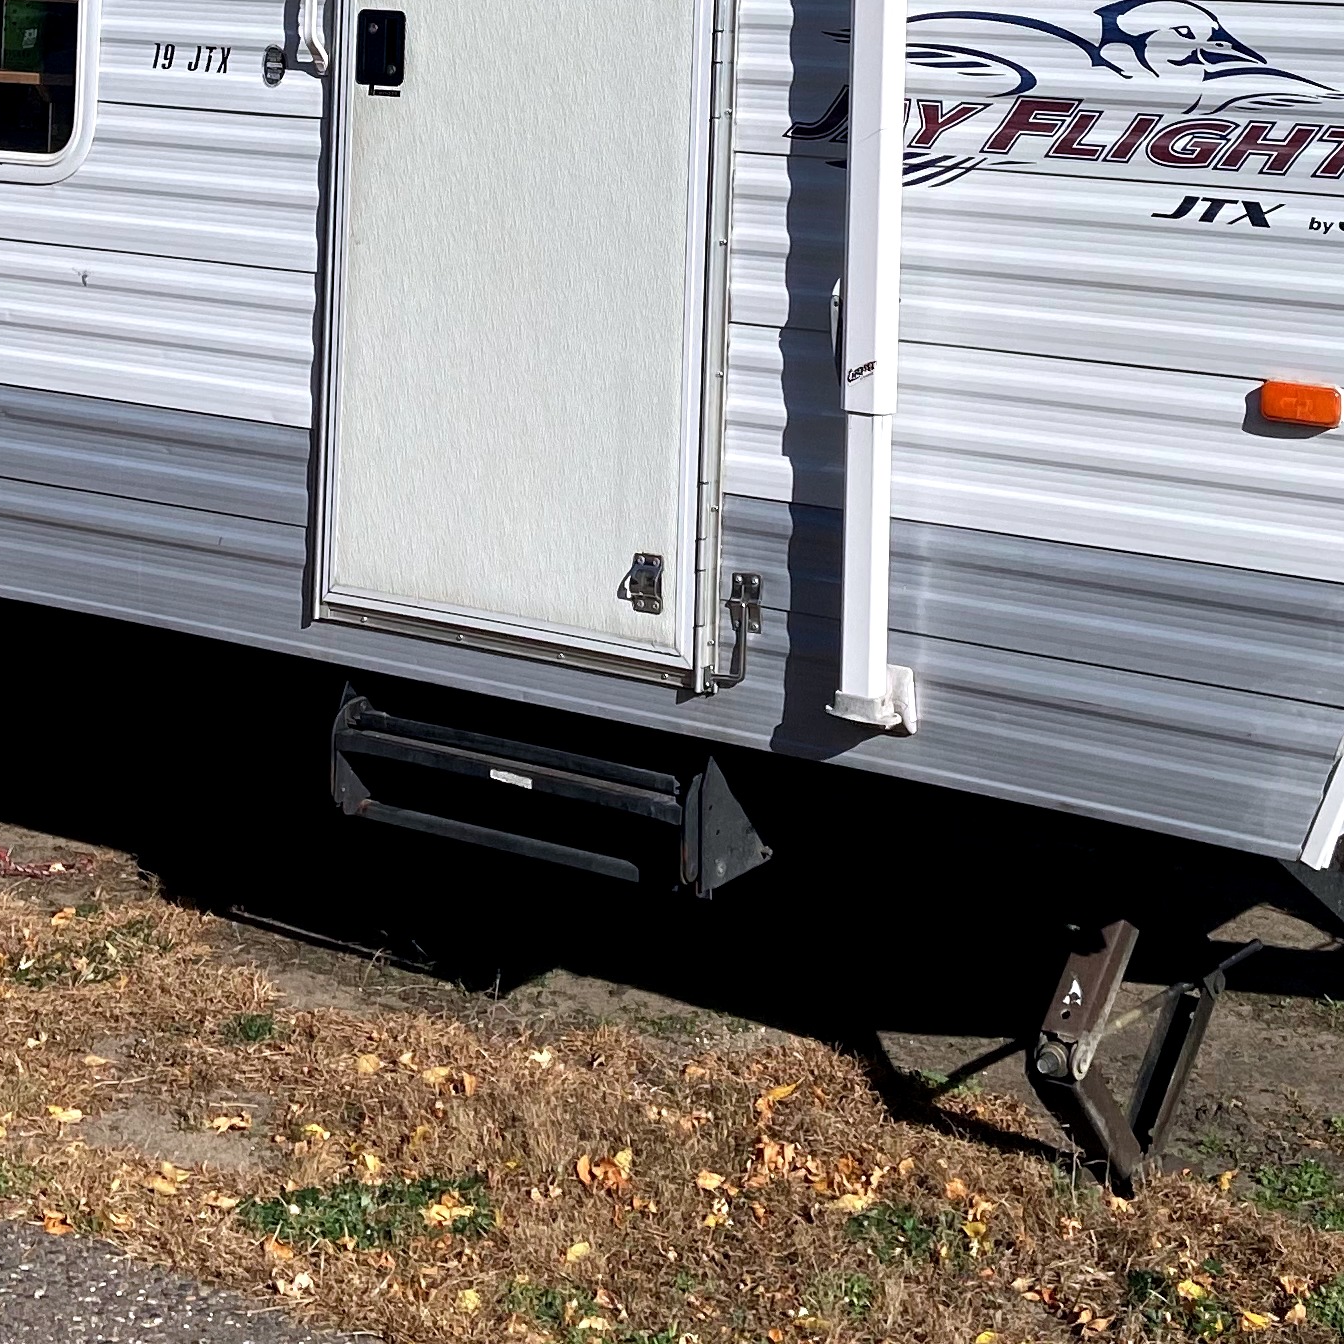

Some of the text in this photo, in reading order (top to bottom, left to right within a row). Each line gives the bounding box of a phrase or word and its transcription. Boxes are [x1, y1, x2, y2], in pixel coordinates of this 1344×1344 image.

[152, 42, 231, 74] 19 JTX
[782, 83, 994, 150] JY
[1150, 195, 1286, 229] JTX
[1308, 216, 1335, 235] by
